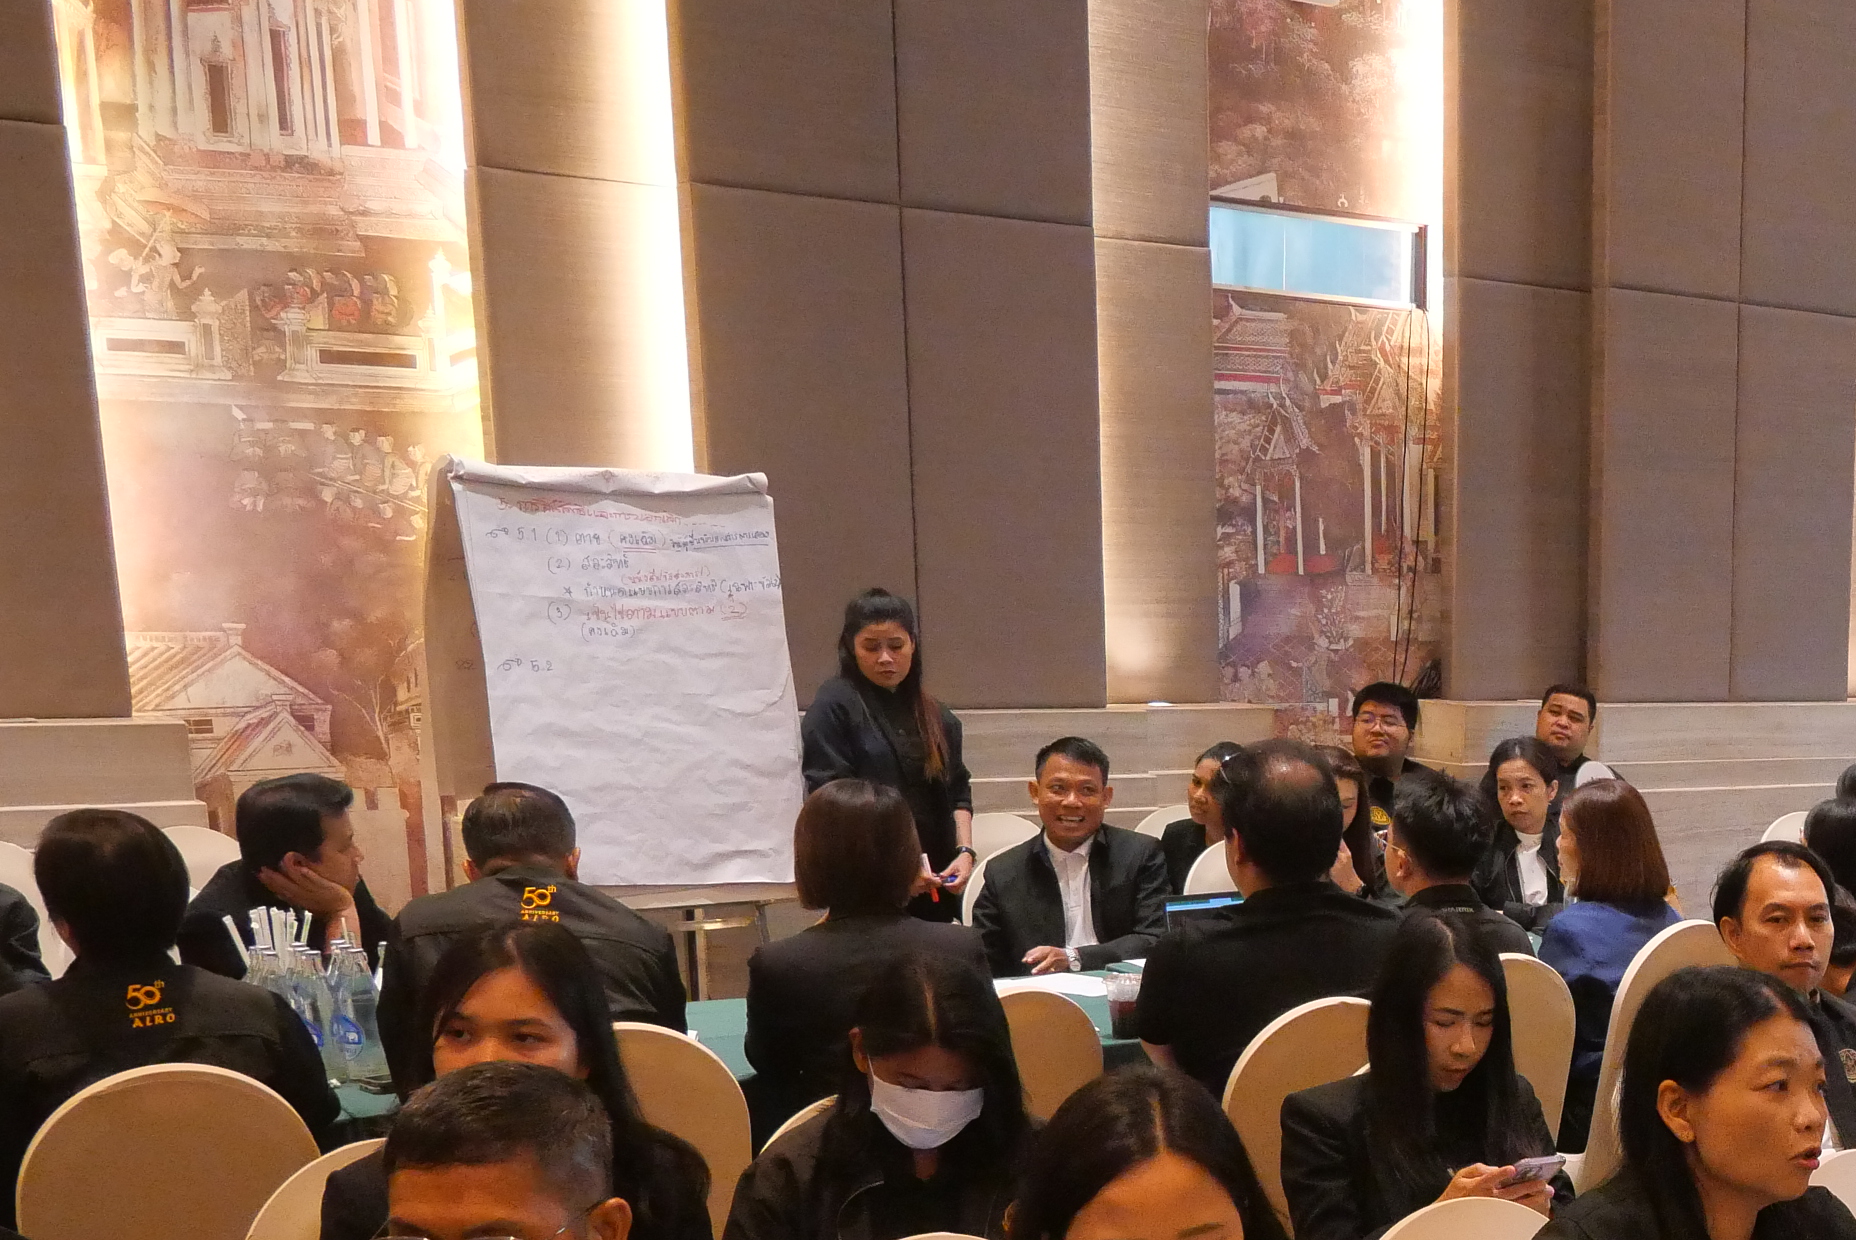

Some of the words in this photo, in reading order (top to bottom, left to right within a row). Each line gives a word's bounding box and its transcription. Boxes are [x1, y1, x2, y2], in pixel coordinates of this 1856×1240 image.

[548, 555, 571, 574] (2)
[547, 601, 571, 624] (3)
[132, 1013, 175, 1028] ALRO
